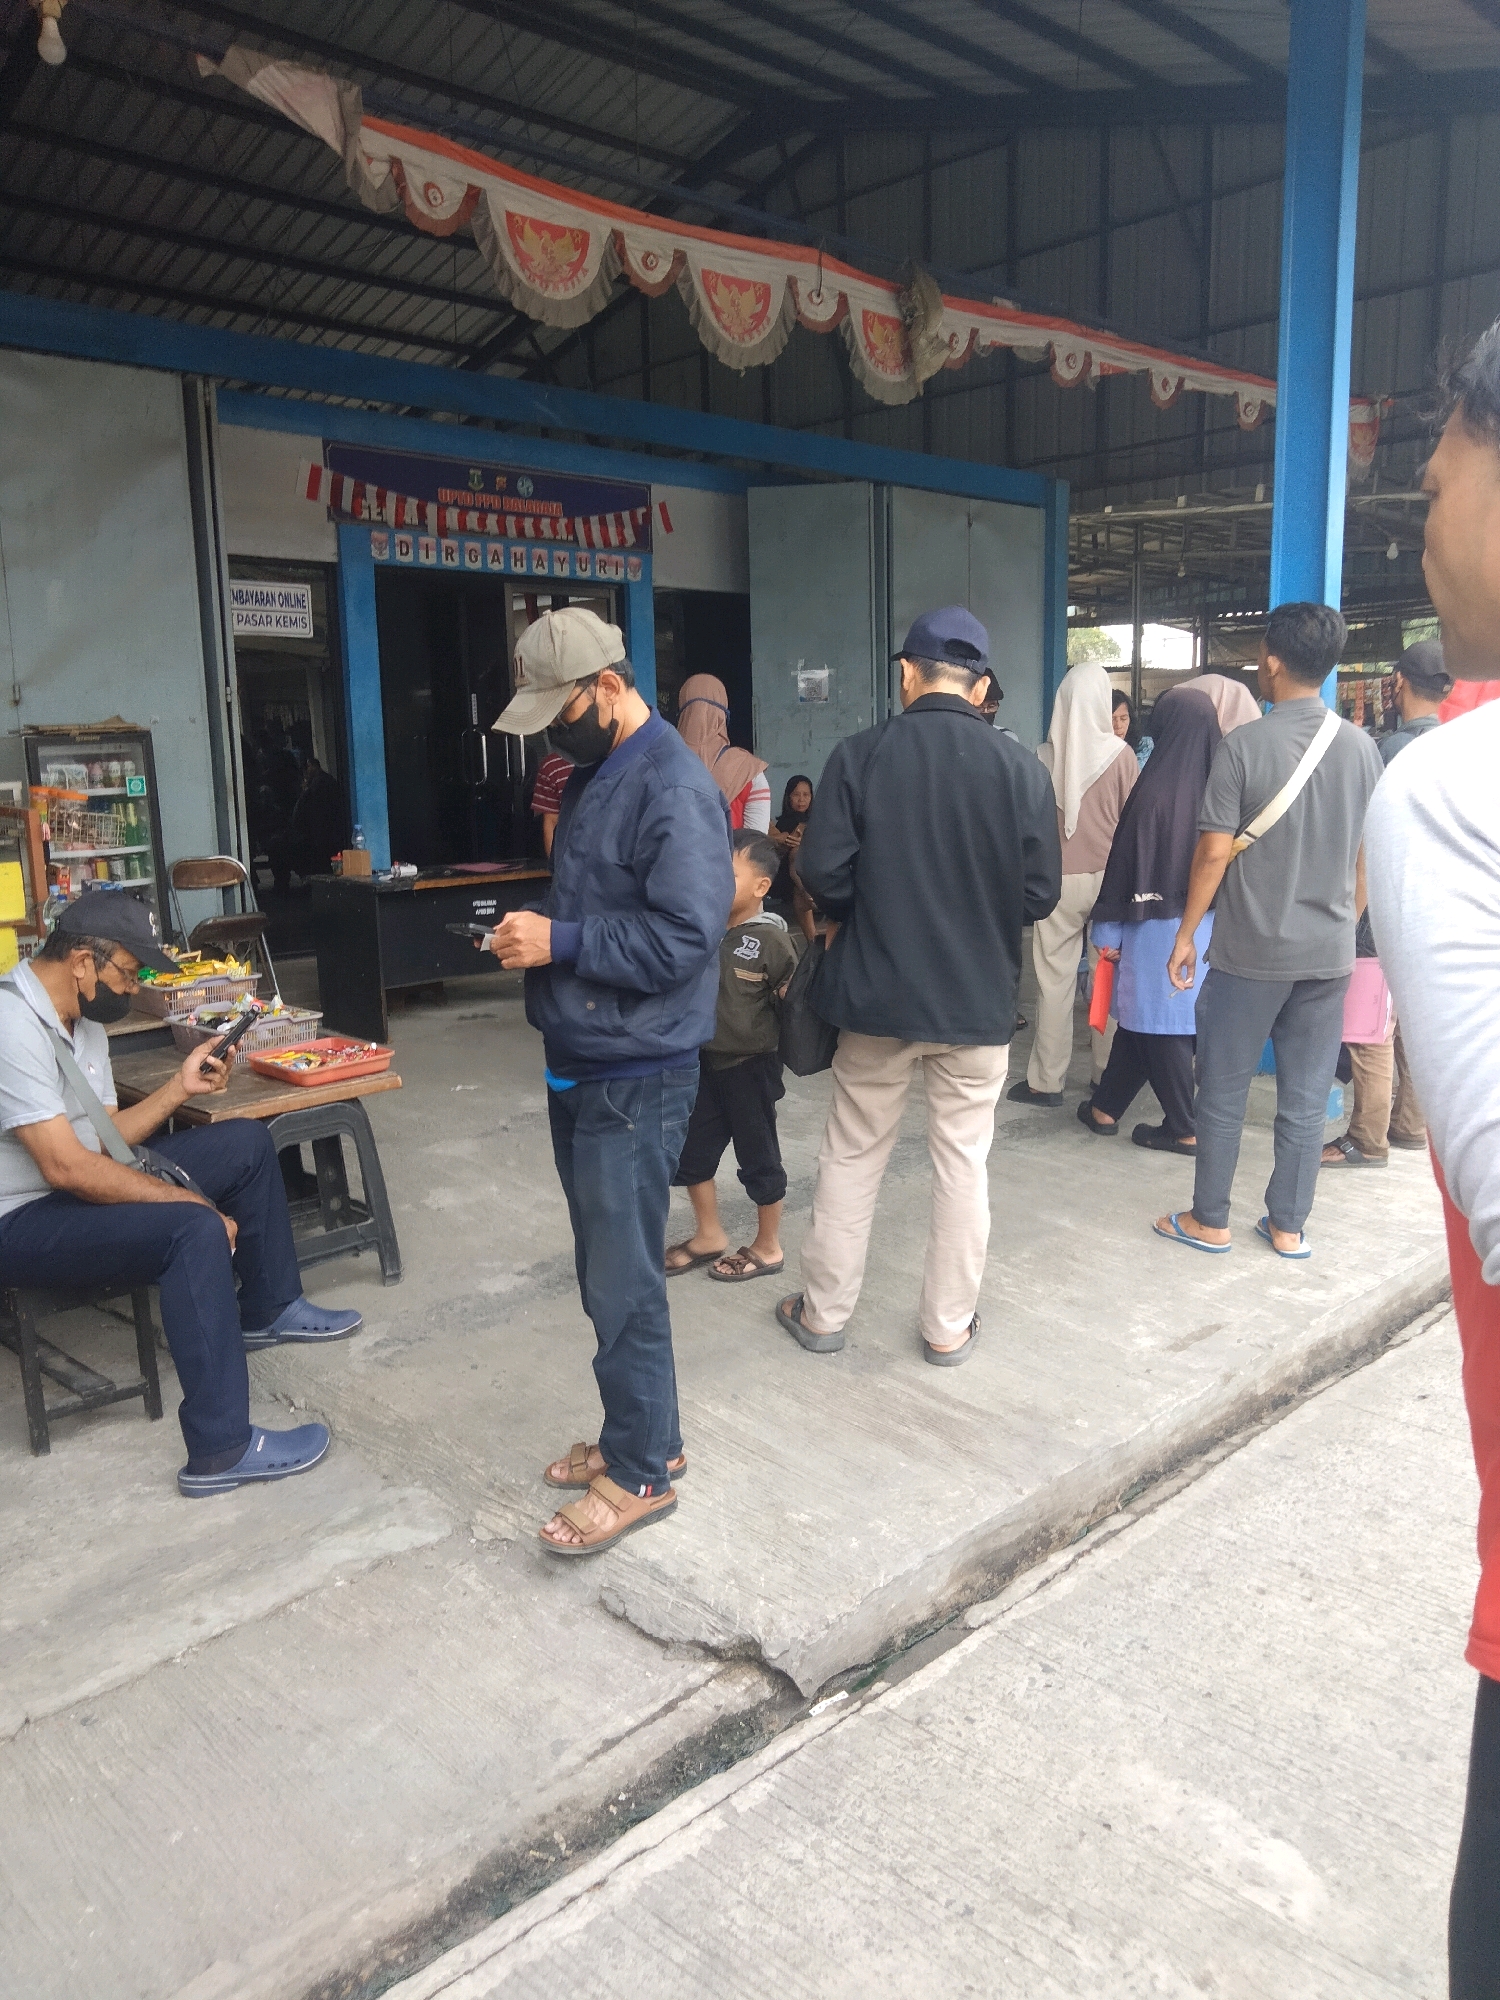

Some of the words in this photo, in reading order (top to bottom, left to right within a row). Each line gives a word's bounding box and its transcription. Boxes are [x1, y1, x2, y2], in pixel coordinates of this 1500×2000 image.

[278, 591, 307, 609] ONLINE
[237, 614, 272, 627] PASAR
[275, 615, 308, 629] KEMIS
